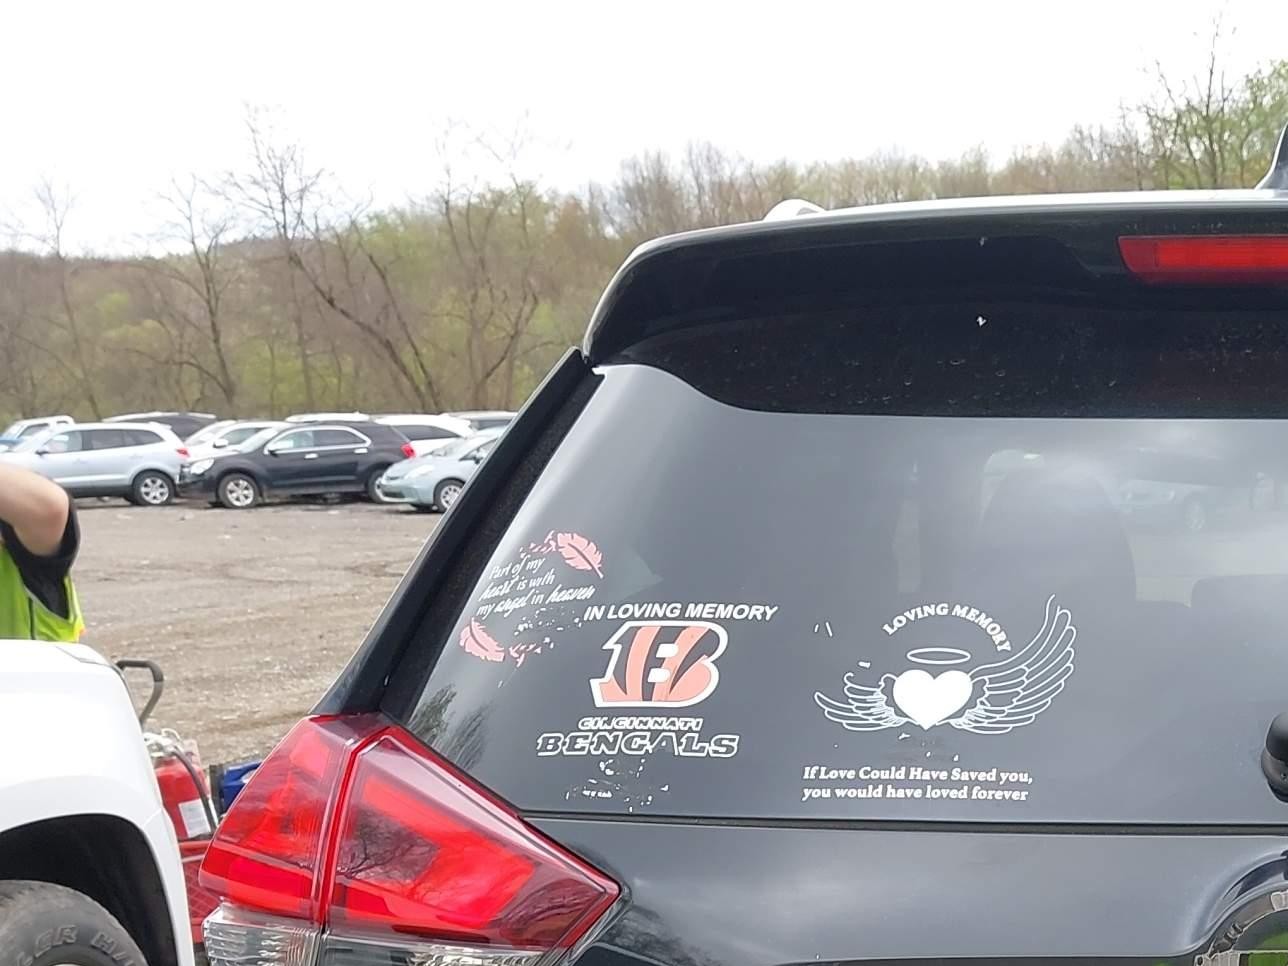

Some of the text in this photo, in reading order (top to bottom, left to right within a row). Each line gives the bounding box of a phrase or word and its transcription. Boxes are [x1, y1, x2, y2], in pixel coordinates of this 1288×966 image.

[526, 558, 546, 573] my
[517, 576, 528, 590] is
[529, 568, 555, 588] with
[476, 602, 495, 620] my
[531, 589, 544, 604] in
[546, 584, 596, 604] heaven
[584, 603, 778, 620] IN LOVING MEMORY
[883, 603, 1011, 652] LOVING MEMORY
[578, 717, 703, 731] CINCINNATI
[536, 732, 740, 757] BENGALS
[802, 766, 1033, 785] If Love Could Have Saved you,
[801, 784, 1029, 801] you would have loved forever
